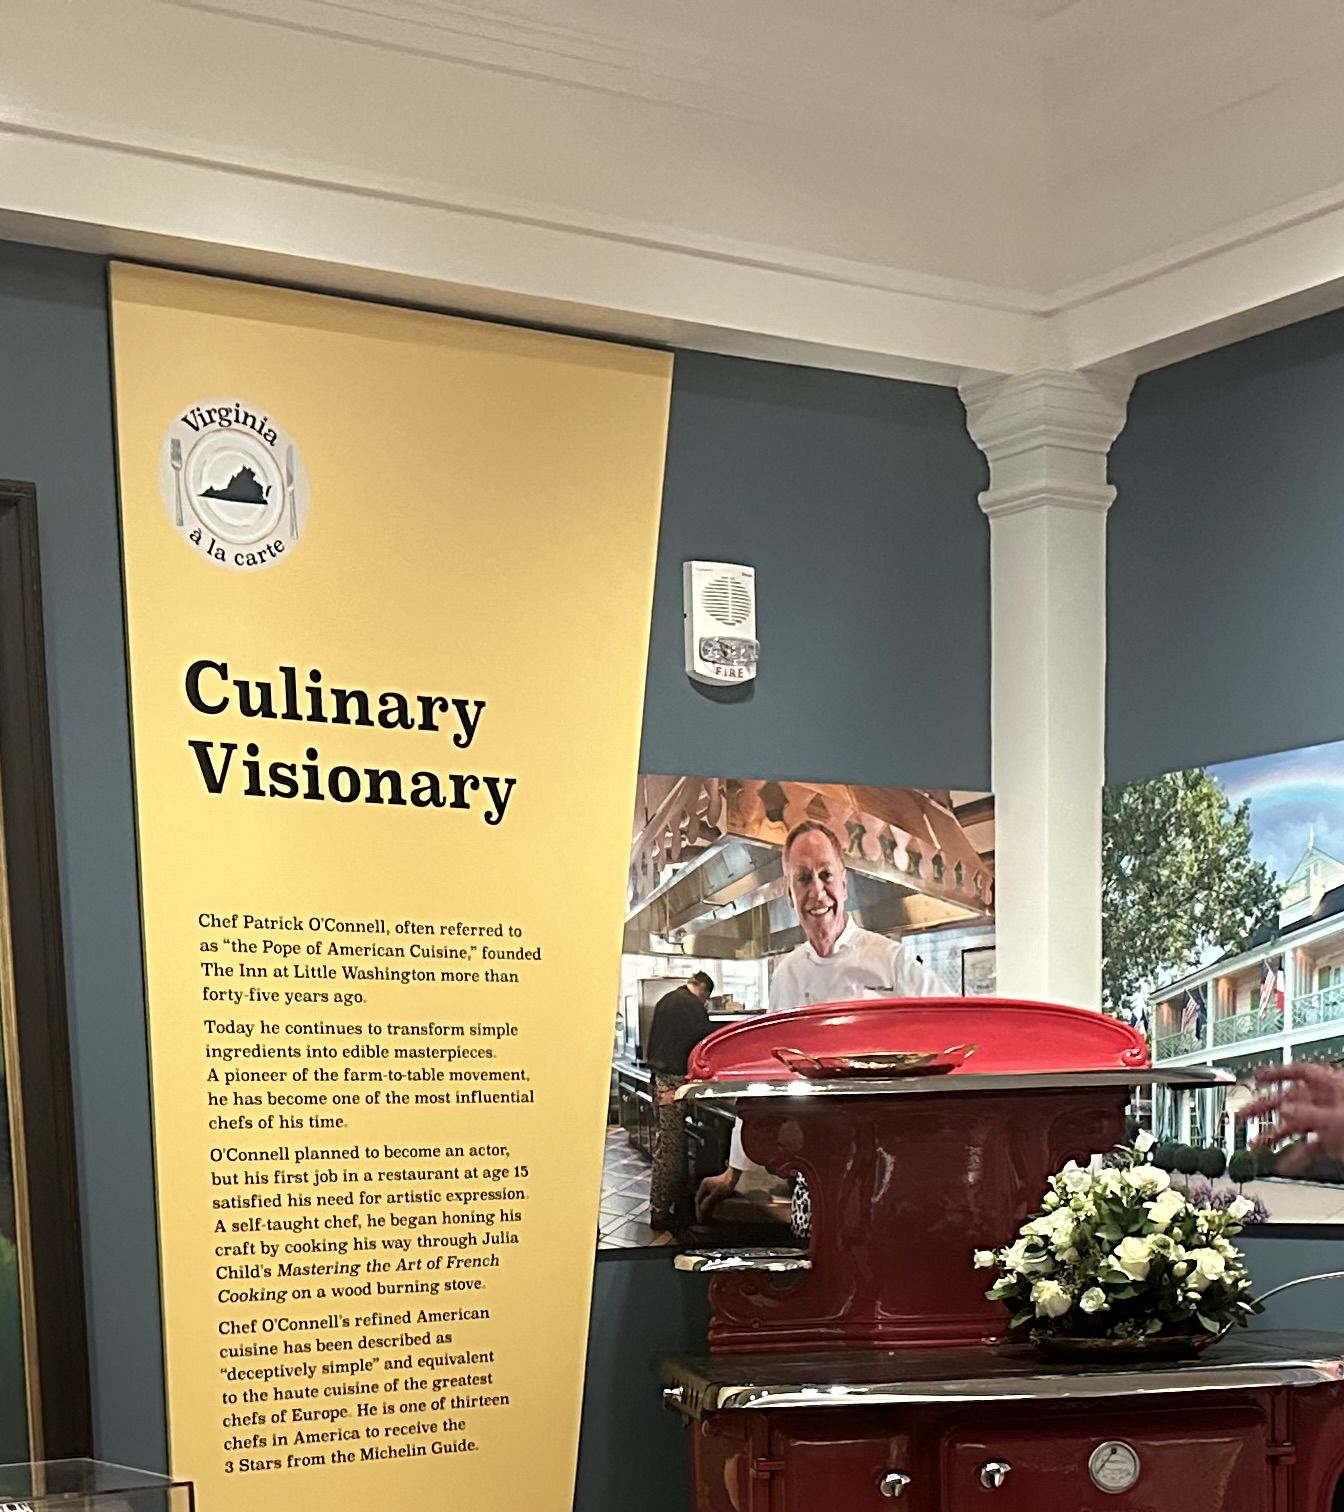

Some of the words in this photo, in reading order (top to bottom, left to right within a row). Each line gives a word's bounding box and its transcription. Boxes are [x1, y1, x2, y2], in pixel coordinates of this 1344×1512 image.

[182, 402, 278, 447] Virginia
[188, 526, 204, 546] à
[206, 538, 227, 564] la
[233, 535, 287, 567] carte
[715, 666, 744, 679] FIRE
[184, 659, 486, 749] Culinary
[188, 739, 517, 826] Visionary
[198, 913, 239, 929] Chef
[242, 914, 304, 931] Patrick
[308, 916, 391, 936] O'Connell,
[394, 920, 436, 936] often
[439, 921, 504, 938] referred
[508, 925, 523, 938] to
[199, 941, 219, 953] as
[262, 939, 302, 959] Pope
[306, 940, 323, 956] of
[327, 941, 406, 958] American
[481, 945, 542, 961] founded
[200, 961, 234, 978] The
[238, 962, 268, 978] Inn
[272, 965, 290, 978] at
[293, 964, 337, 980] Little
[341, 965, 436, 985] Washington
[440, 971, 480, 983] more
[484, 968, 520, 983] than
[202, 985, 280, 1006] forty-five
[284, 991, 329, 1006] years
[203, 1019, 256, 1038] Today
[259, 1019, 280, 1035] he
[284, 1020, 363, 1036] continues
[367, 1022, 383, 1036] to
[386, 1021, 465, 1037] transform
[469, 1021, 519, 1040] simple
[205, 1043, 302, 1062] ingredients
[305, 1044, 338, 1059] into
[342, 1043, 390, 1059] edible
[206, 1067, 220, 1082] A
[224, 1067, 288, 1086] pioneer
[292, 1067, 309, 1082] of
[313, 1067, 339, 1082] the
[343, 1067, 445, 1082] farm-to-table
[448, 1069, 530, 1083] movement,
[207, 1091, 229, 1106] he
[232, 1091, 263, 1106] has
[266, 1090, 328, 1106] become
[332, 1094, 361, 1105] one
[364, 1090, 382, 1105] of
[385, 1090, 410, 1105] the
[414, 1091, 452, 1105] most
[455, 1089, 535, 1104] influential
[208, 1115, 254, 1130] chefs
[257, 1114, 275, 1130] of
[278, 1114, 304, 1129] his
